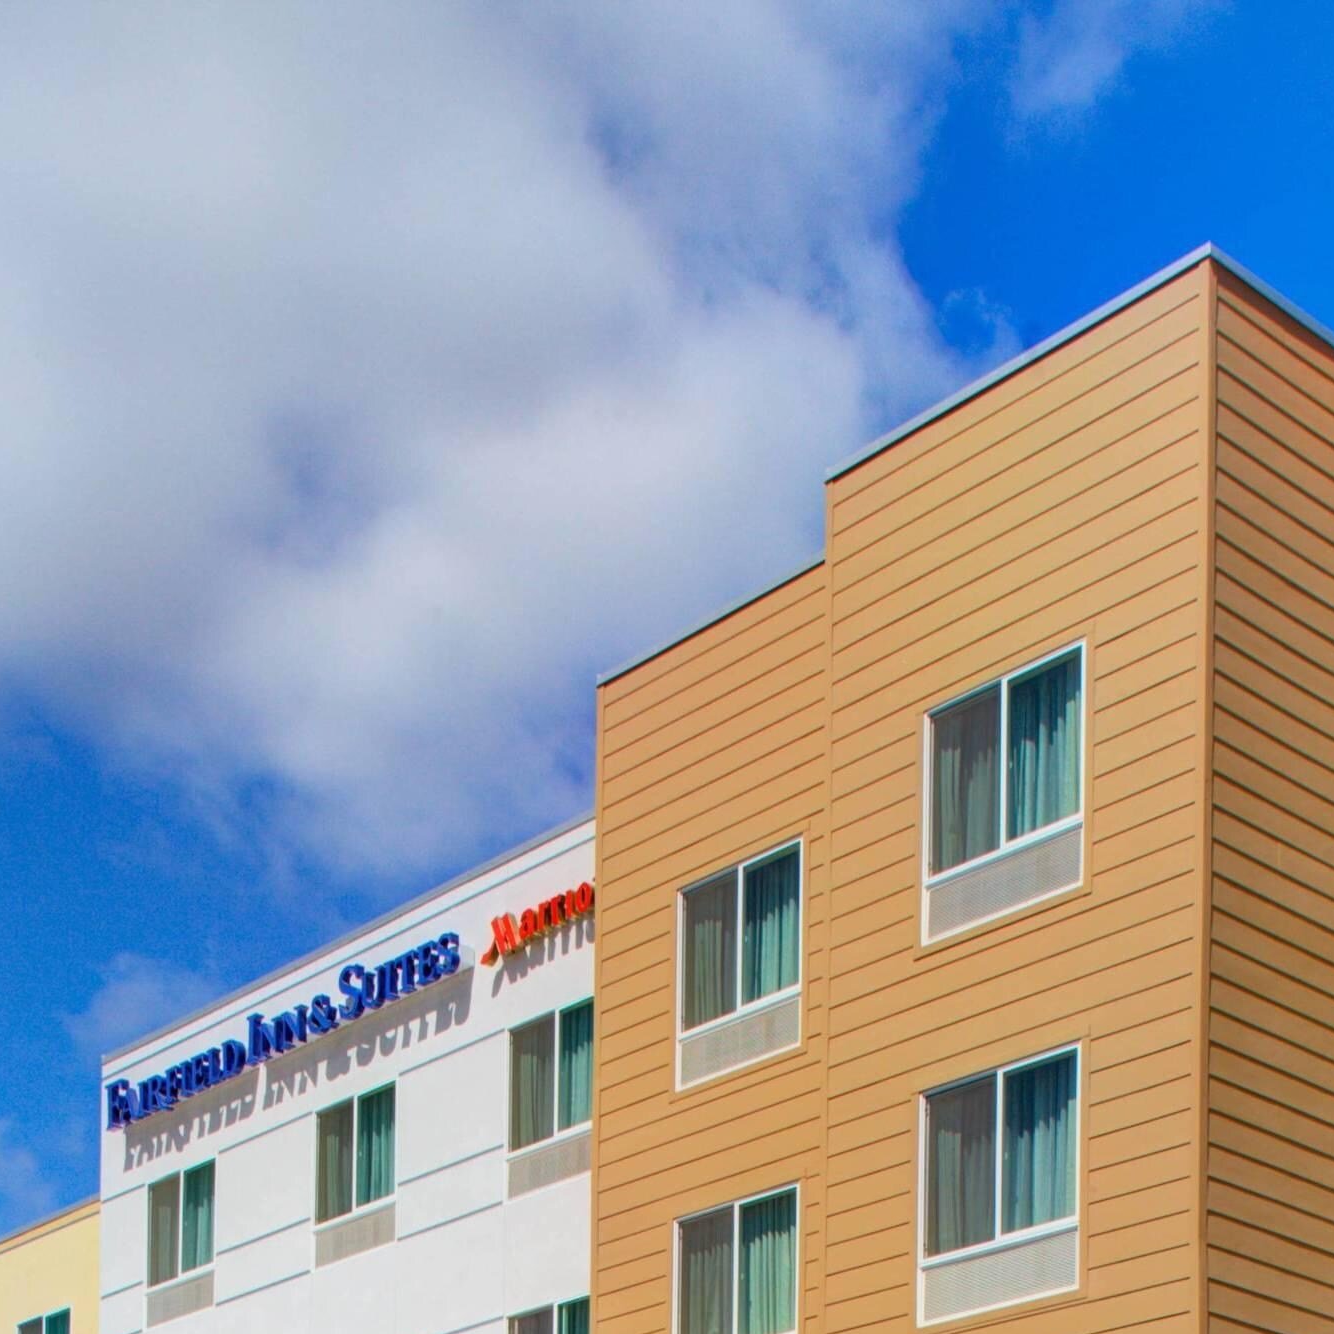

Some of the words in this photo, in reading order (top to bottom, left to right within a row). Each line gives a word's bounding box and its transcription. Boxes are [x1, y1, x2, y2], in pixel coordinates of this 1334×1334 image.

[480, 881, 595, 967] Marrio
[105, 1039, 246, 1131] FAIRFIELD
[247, 1003, 309, 1066] INN
[307, 993, 340, 1034] &
[338, 931, 461, 1020] SUITES
